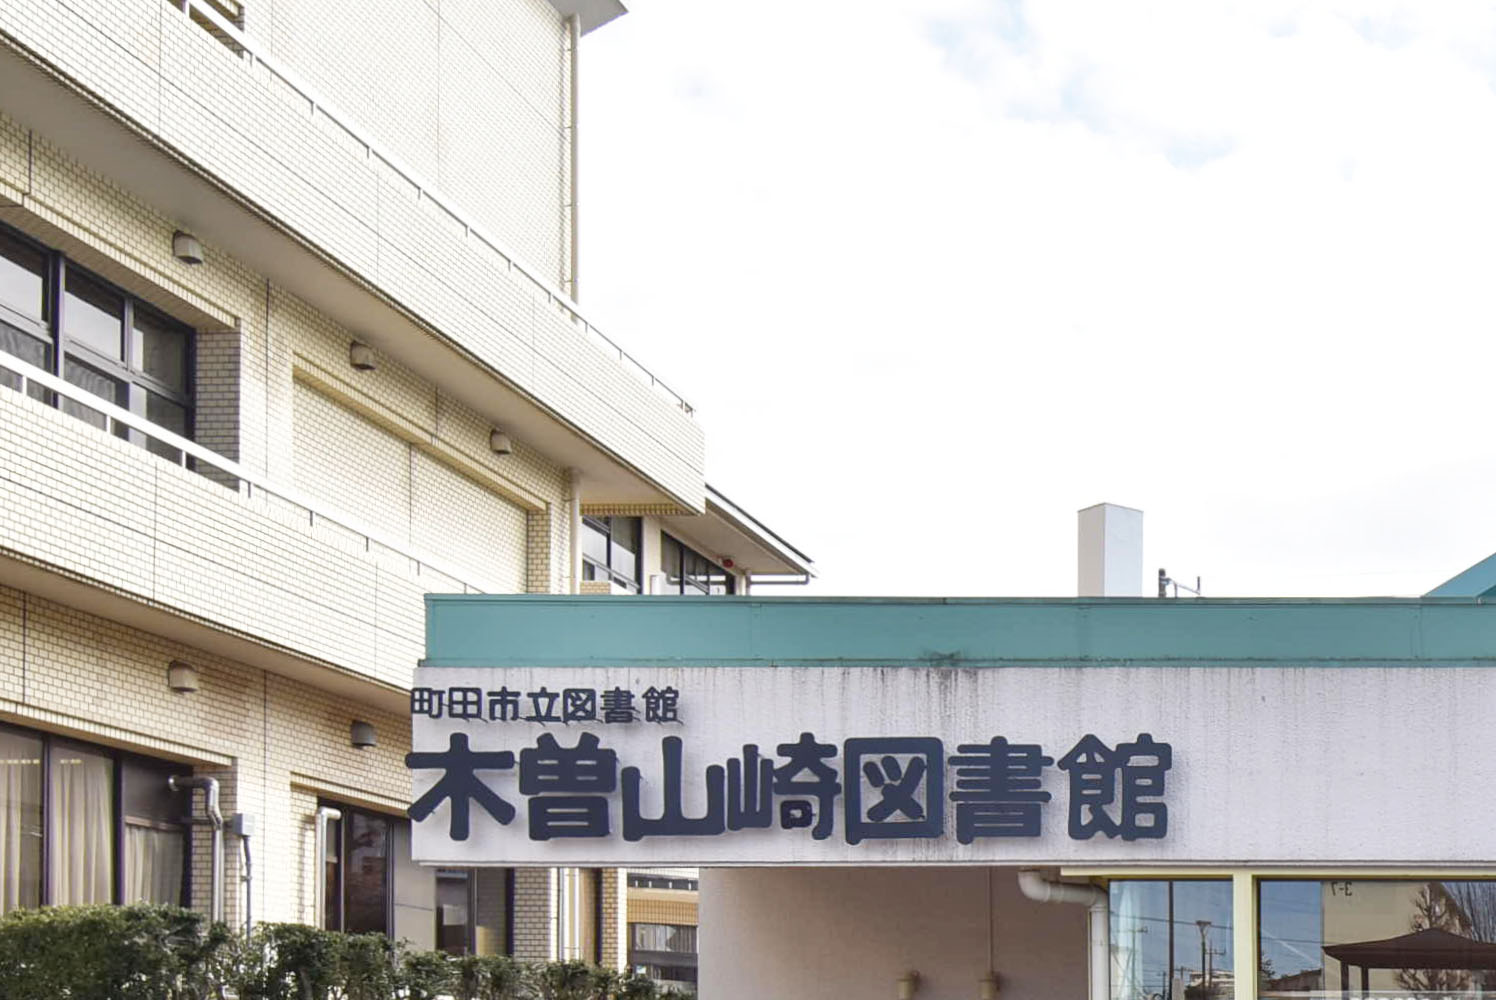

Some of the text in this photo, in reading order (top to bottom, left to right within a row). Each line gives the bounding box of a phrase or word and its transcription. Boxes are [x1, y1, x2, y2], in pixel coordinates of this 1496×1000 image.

[410, 686, 680, 723] 町田市立図書館
[404, 731, 1173, 843] 木曽山崎図書館
